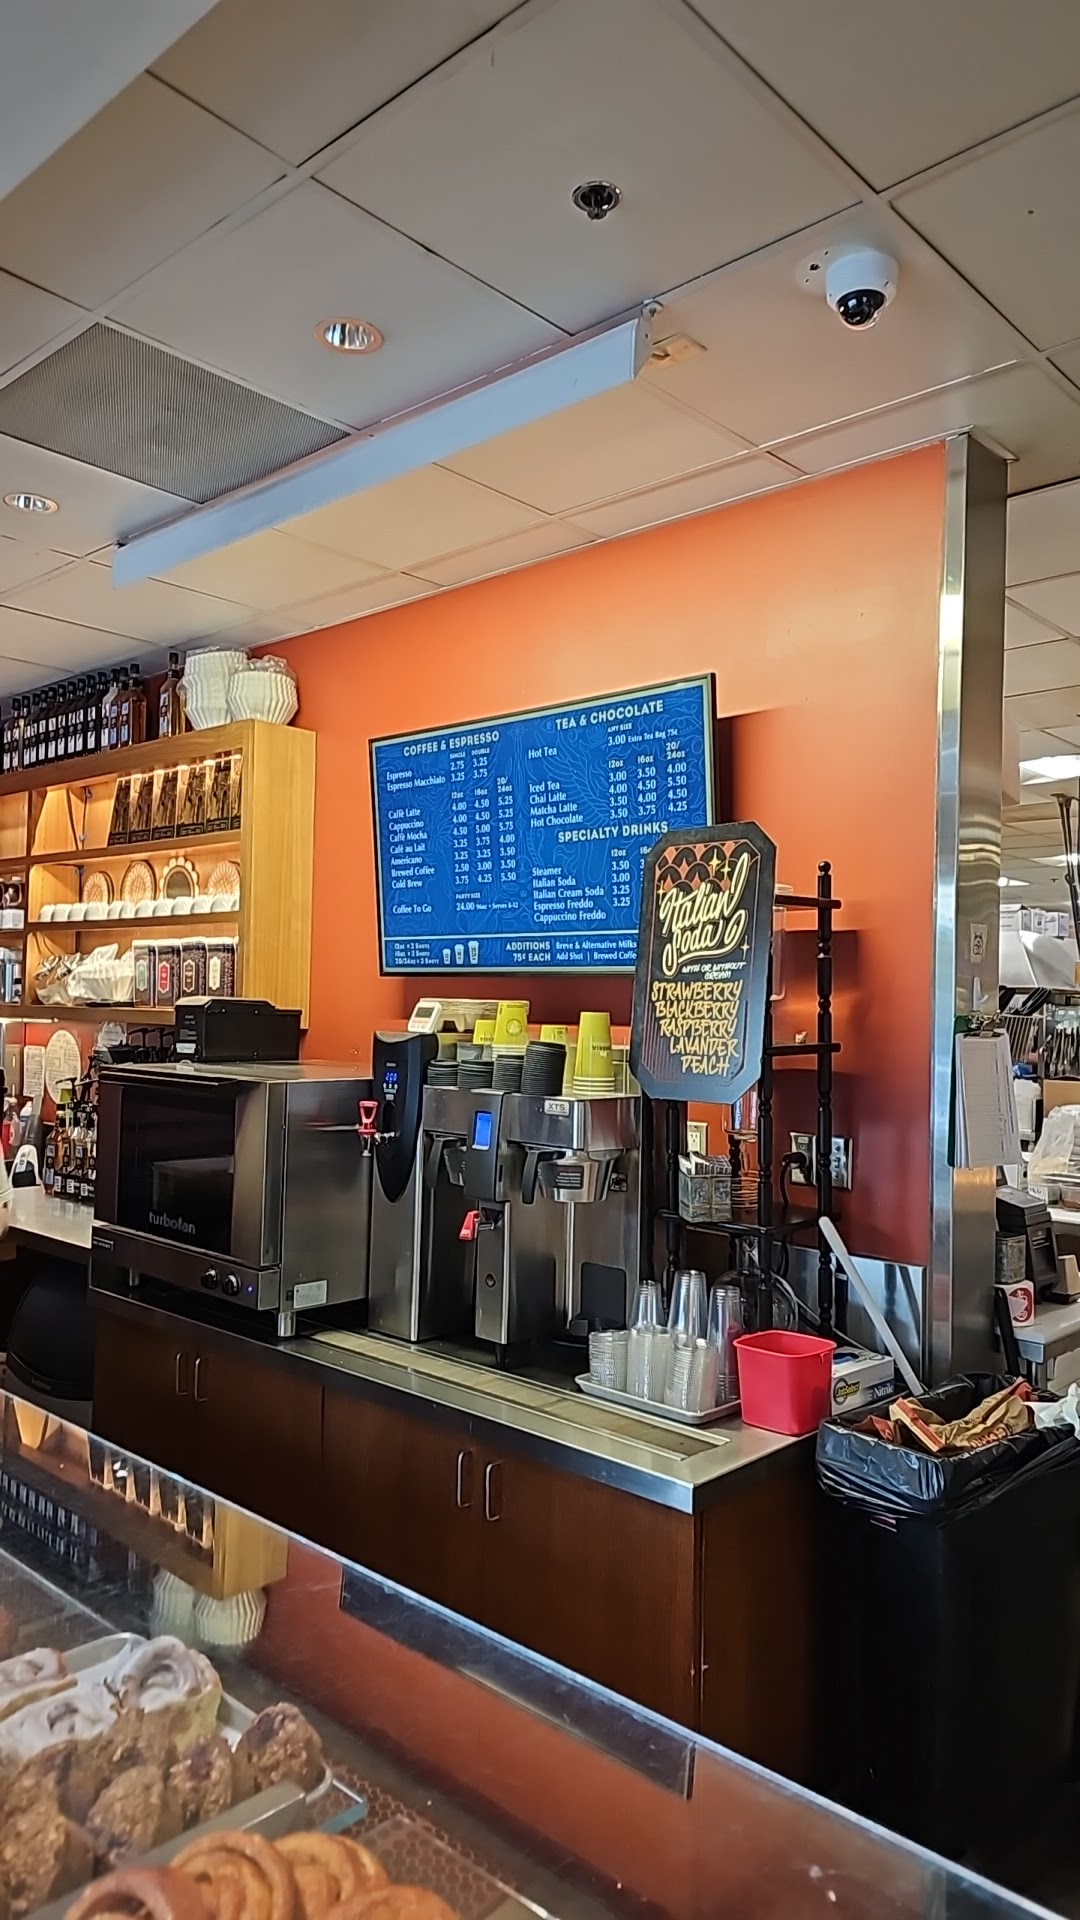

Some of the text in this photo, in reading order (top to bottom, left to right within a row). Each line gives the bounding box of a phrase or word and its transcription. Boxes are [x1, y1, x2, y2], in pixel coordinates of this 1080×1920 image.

[556, 700, 664, 730] TEA & CHOCOLATE
[620, 723, 632, 731] SIZE
[404, 731, 499, 756] COFFEE & ESPRESSO
[529, 749, 542, 759] Hot
[543, 747, 557, 756] Tea
[607, 735, 625, 746] 3.00
[628, 735, 642, 743] Extra
[644, 732, 653, 740] Tea
[655, 731, 666, 740] Bag
[666, 741, 680, 750] 20/
[387, 757, 487, 782] Espresso 2.75 3.25
[608, 751, 685, 768] 12oz 16oz 24oz
[387, 769, 487, 793] Espresso Macchiato 3.25 3.75
[529, 762, 687, 793] Iced Tea 3.00 3.50 4.00
[530, 775, 687, 804] Chai Latte 4.00 4.50 5.50
[406, 808, 421, 817] Latte
[452, 802, 467, 811] 4.00
[474, 799, 489, 809] 4.50
[498, 796, 513, 806] 5.25
[530, 788, 687, 816] Matcha Latte 3.50 4.00 4.50
[389, 808, 513, 832] Cappuccino 4.00 4.50 5.25
[531, 800, 687, 828] Hot Chocolate 3.50 3.75 4.25
[407, 831, 427, 841] Mocha
[453, 827, 468, 836] 4.50
[476, 824, 490, 834] 5.00
[499, 821, 513, 831] 5.75
[558, 821, 668, 843] SPECIALTY DRINKS
[414, 843, 425, 852] Lait
[453, 839, 468, 848] 3.25
[476, 836, 490, 846] 3.75
[499, 834, 515, 844] 4.00
[611, 849, 626, 857] 12oz
[391, 847, 515, 866] Americano 3.25 3.25 3.50
[391, 859, 516, 877] Brewed Coffee 2.50 3.00 3.50
[532, 860, 629, 876] Steamer 3.50
[392, 879, 406, 889] Cold
[455, 875, 469, 885] 3.75
[478, 874, 492, 883] 4.25
[501, 872, 516, 881] 5.50
[533, 873, 630, 888] Italian Soda 3.00
[533, 885, 630, 899] Italian Cream Soda 3.25
[659, 852, 749, 935] Italian
[393, 905, 412, 914] Coffee
[414, 904, 421, 912] To
[422, 904, 432, 912] Go
[456, 902, 475, 911] 24.00
[534, 897, 630, 913] Espresso Freddo 3.25
[534, 909, 606, 924] Cappuccino Freddo
[506, 940, 637, 951] ADDITIONS Breve & Alternative Milks
[663, 909, 745, 975] Soda
[529, 953, 551, 961] EACH
[570, 952, 583, 960] Shot
[594, 951, 617, 959] Brewed
[619, 951, 637, 959] Coffe
[701, 964, 712, 972] OR
[713, 962, 746, 971] WITHOUT
[652, 979, 742, 1001] STRAWBERRY
[655, 1000, 739, 1020] BLACKBERRY
[660, 1018, 737, 1038] RASPBERRY
[670, 1036, 740, 1057] LAVANDER
[681, 1055, 730, 1077] PEACH
[548, 1102, 565, 1110] XTS
[149, 1212, 195, 1234] turbofan
